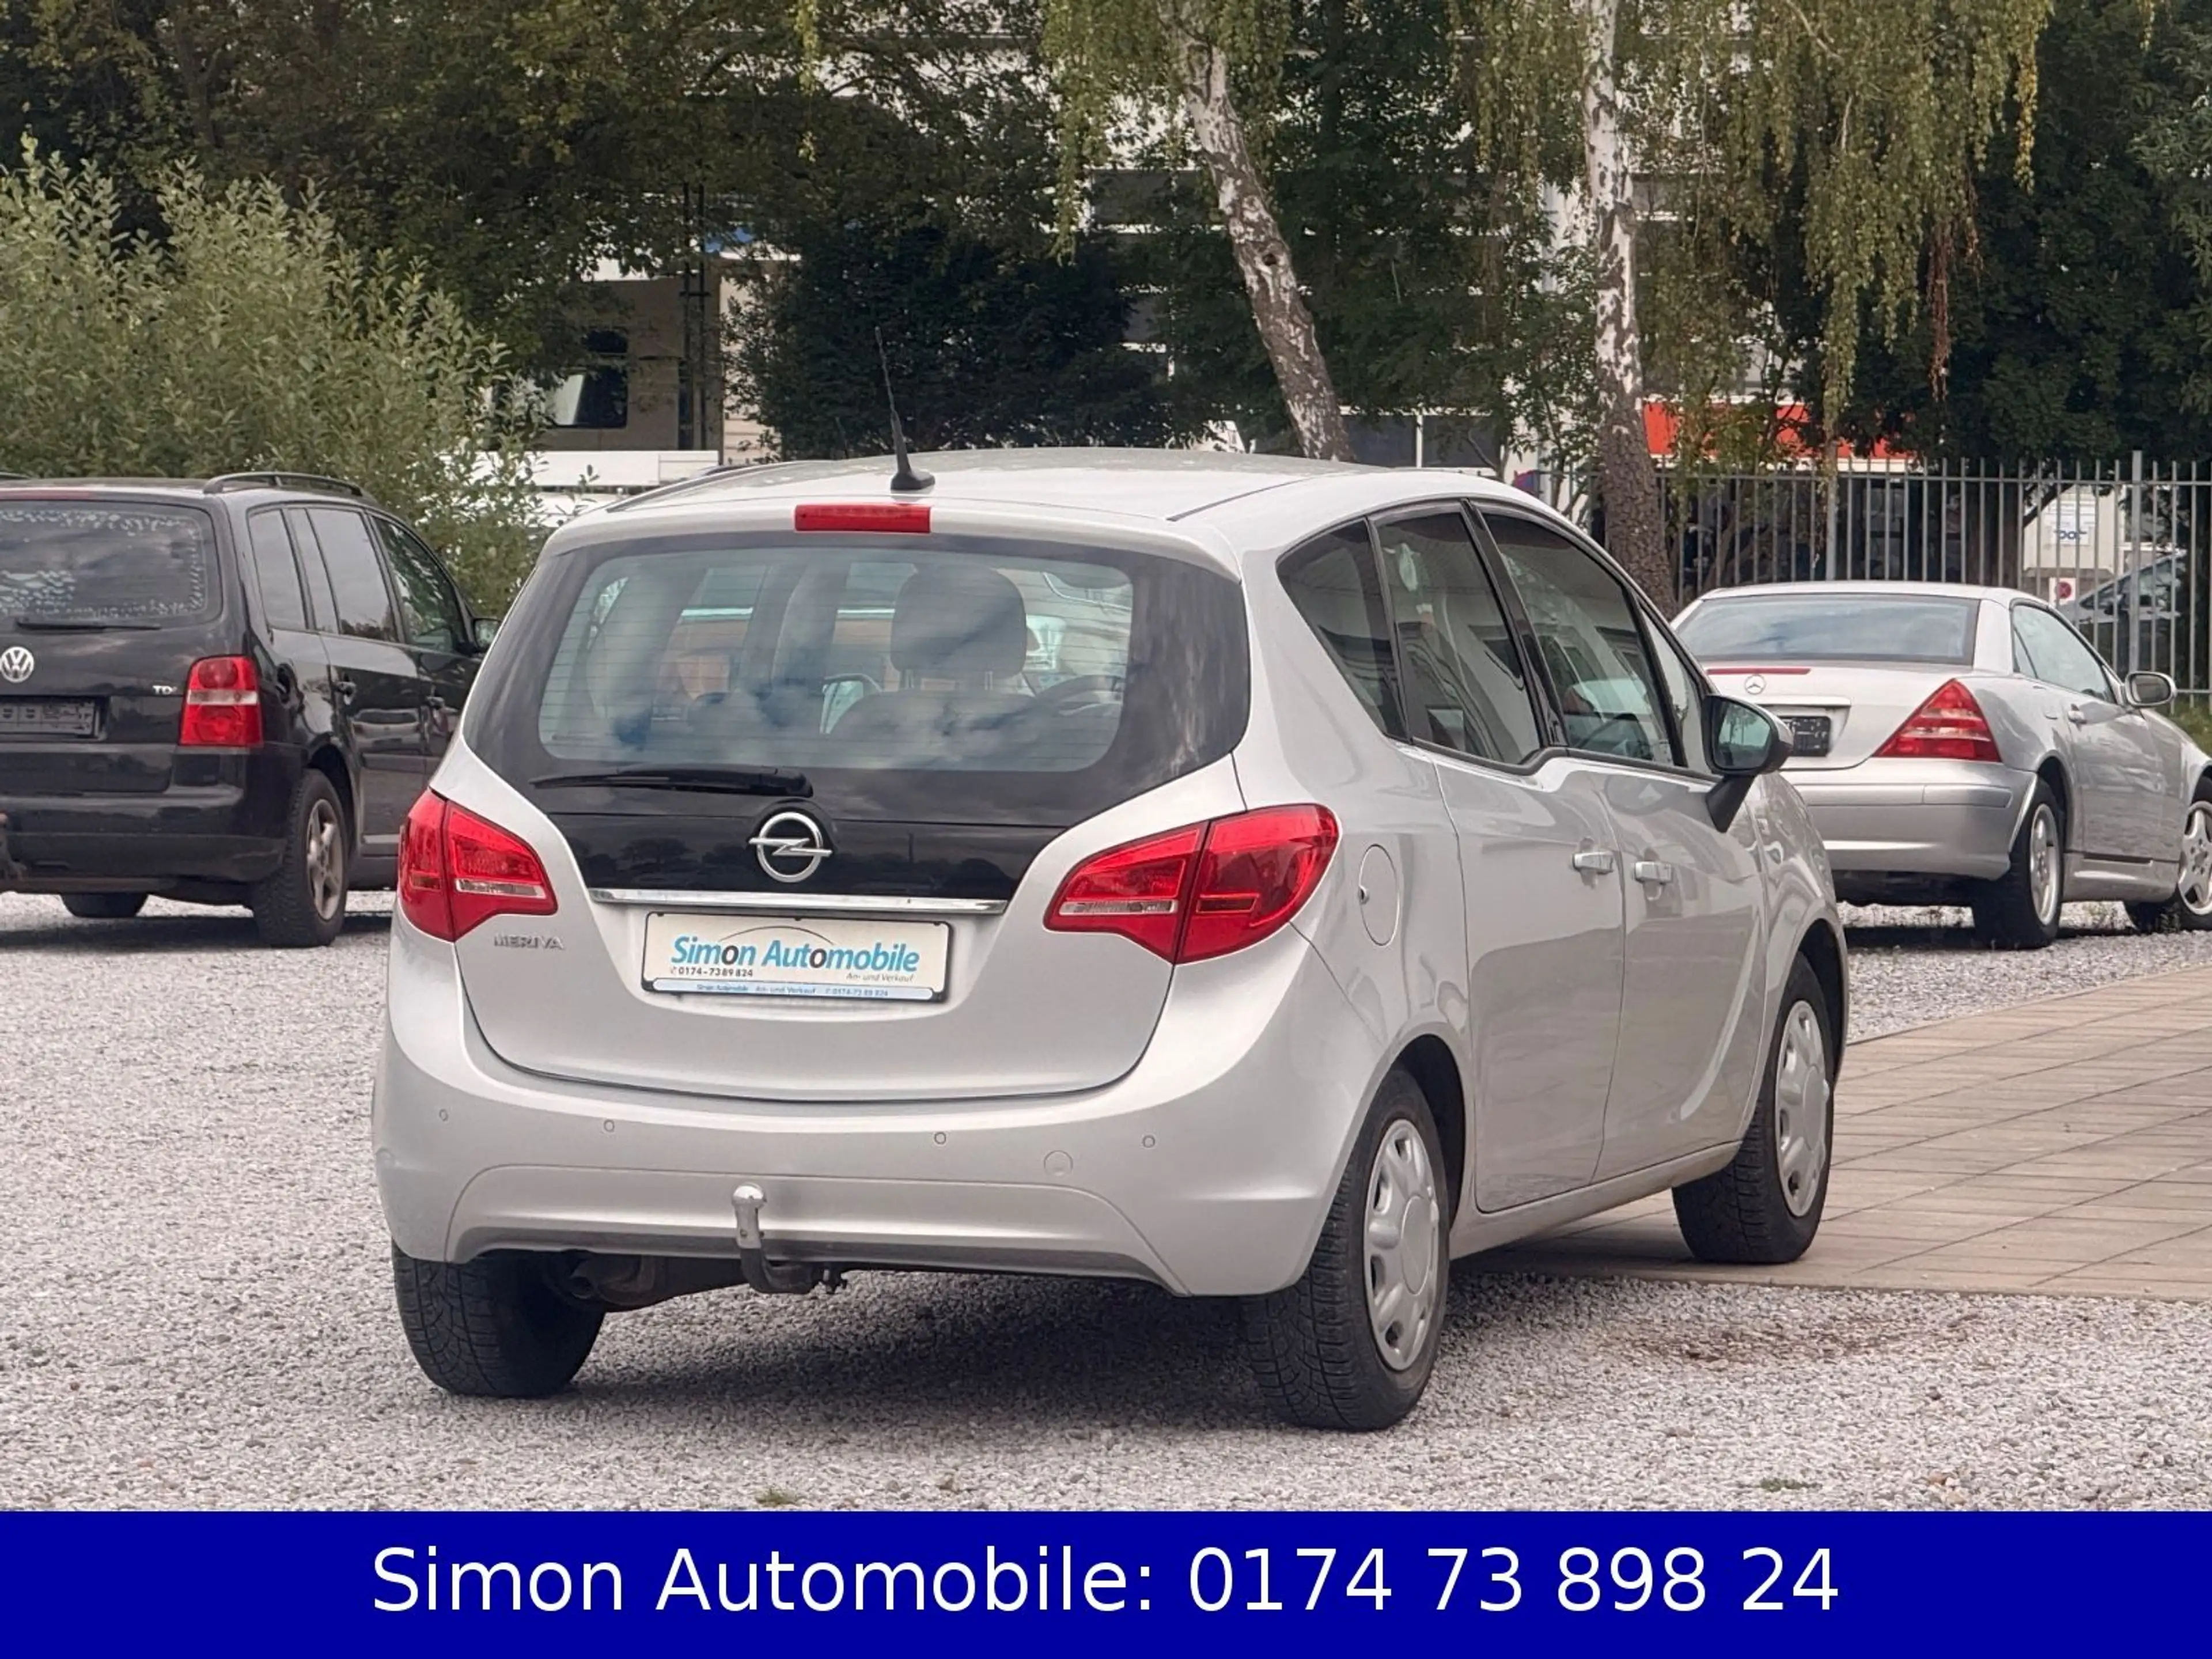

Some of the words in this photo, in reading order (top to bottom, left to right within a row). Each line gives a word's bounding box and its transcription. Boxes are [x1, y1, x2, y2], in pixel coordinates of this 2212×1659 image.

[494, 934, 566, 950] MERIVA
[671, 936, 757, 966] Simon
[761, 940, 920, 972] Automobile
[862, 974, 880, 982] und
[881, 974, 914, 983] Verkauf
